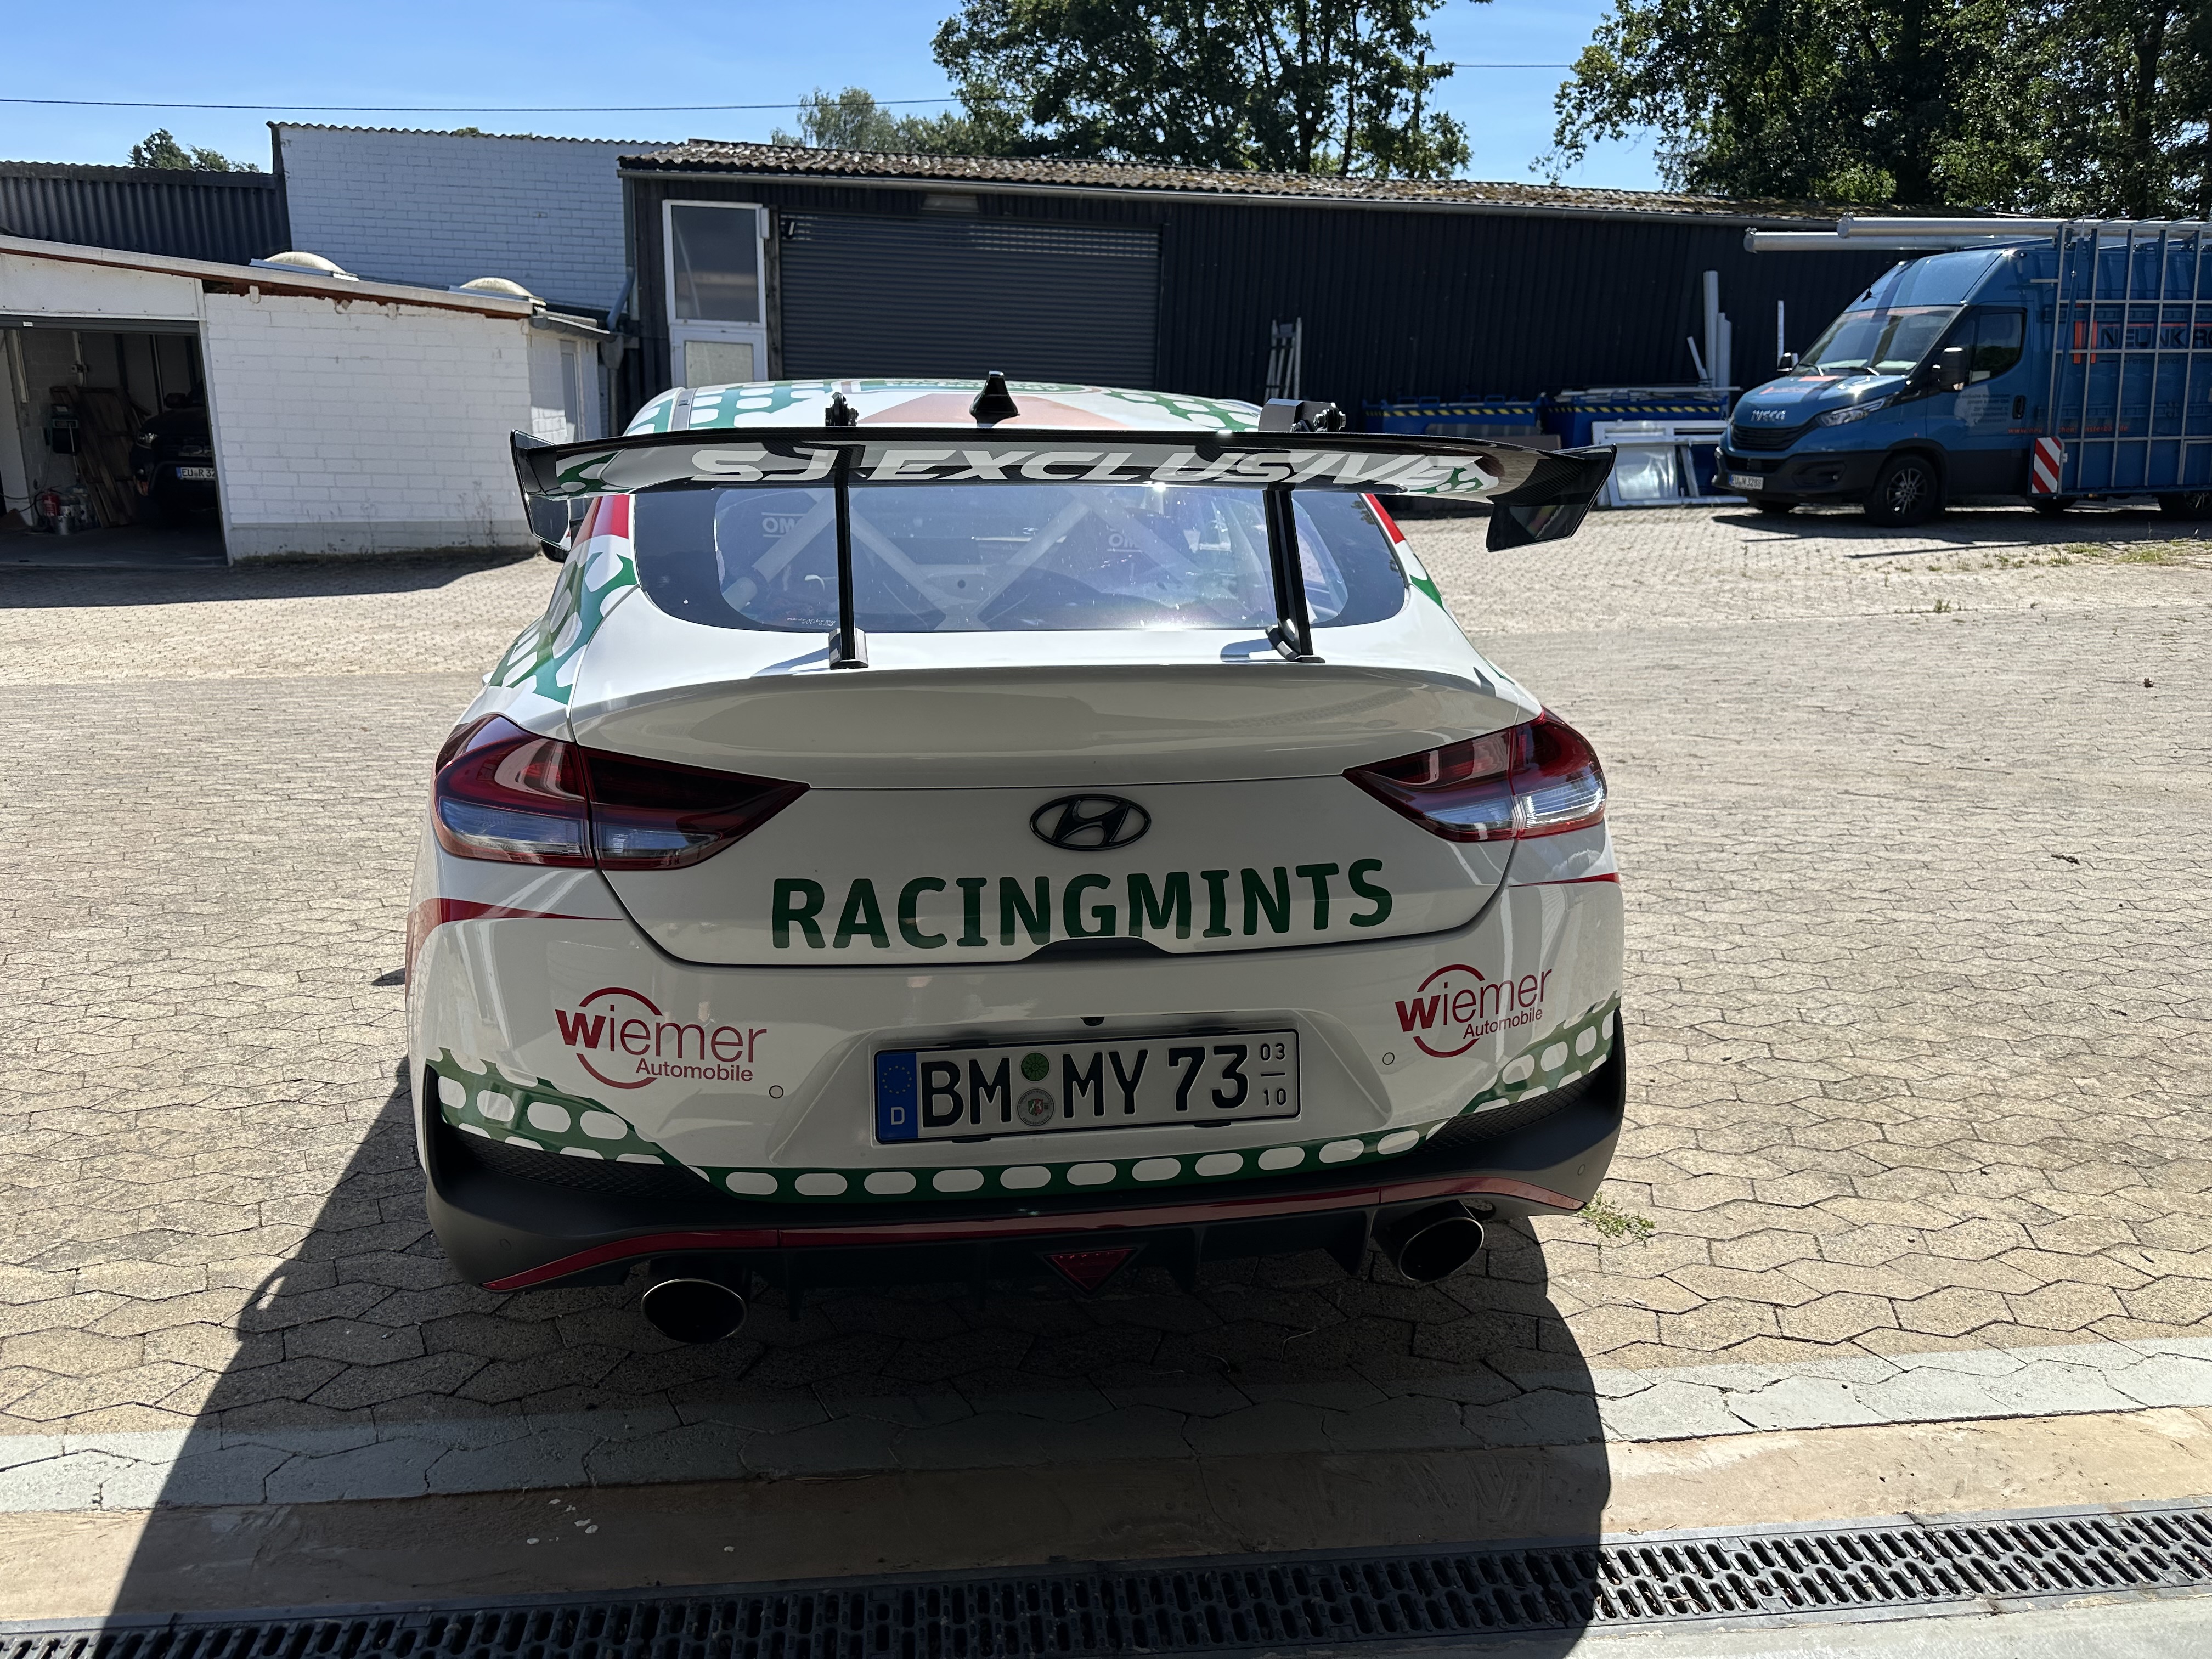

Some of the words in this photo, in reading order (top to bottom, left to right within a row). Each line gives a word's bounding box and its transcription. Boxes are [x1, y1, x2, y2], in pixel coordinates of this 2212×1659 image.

[1750, 410, 1786, 422] IVECO
[182, 468, 194, 477] EU
[198, 469, 204, 477] R
[690, 449, 839, 482] SJ
[867, 449, 1483, 486] EXCLUSIVE
[771, 858, 1393, 950] RACINGMINTS
[1395, 968, 1553, 1032] wiemer
[555, 1004, 768, 1063] wiemer
[1463, 1007, 1543, 1039] Automobile
[1260, 1042, 1285, 1061] 03
[635, 1058, 754, 1082] Automobile
[890, 1106, 905, 1126] D
[921, 1057, 1012, 1128] BM
[1062, 1049, 1149, 1119] MY
[1167, 1044, 1249, 1112] 73
[1263, 1088, 1286, 1107] 10
